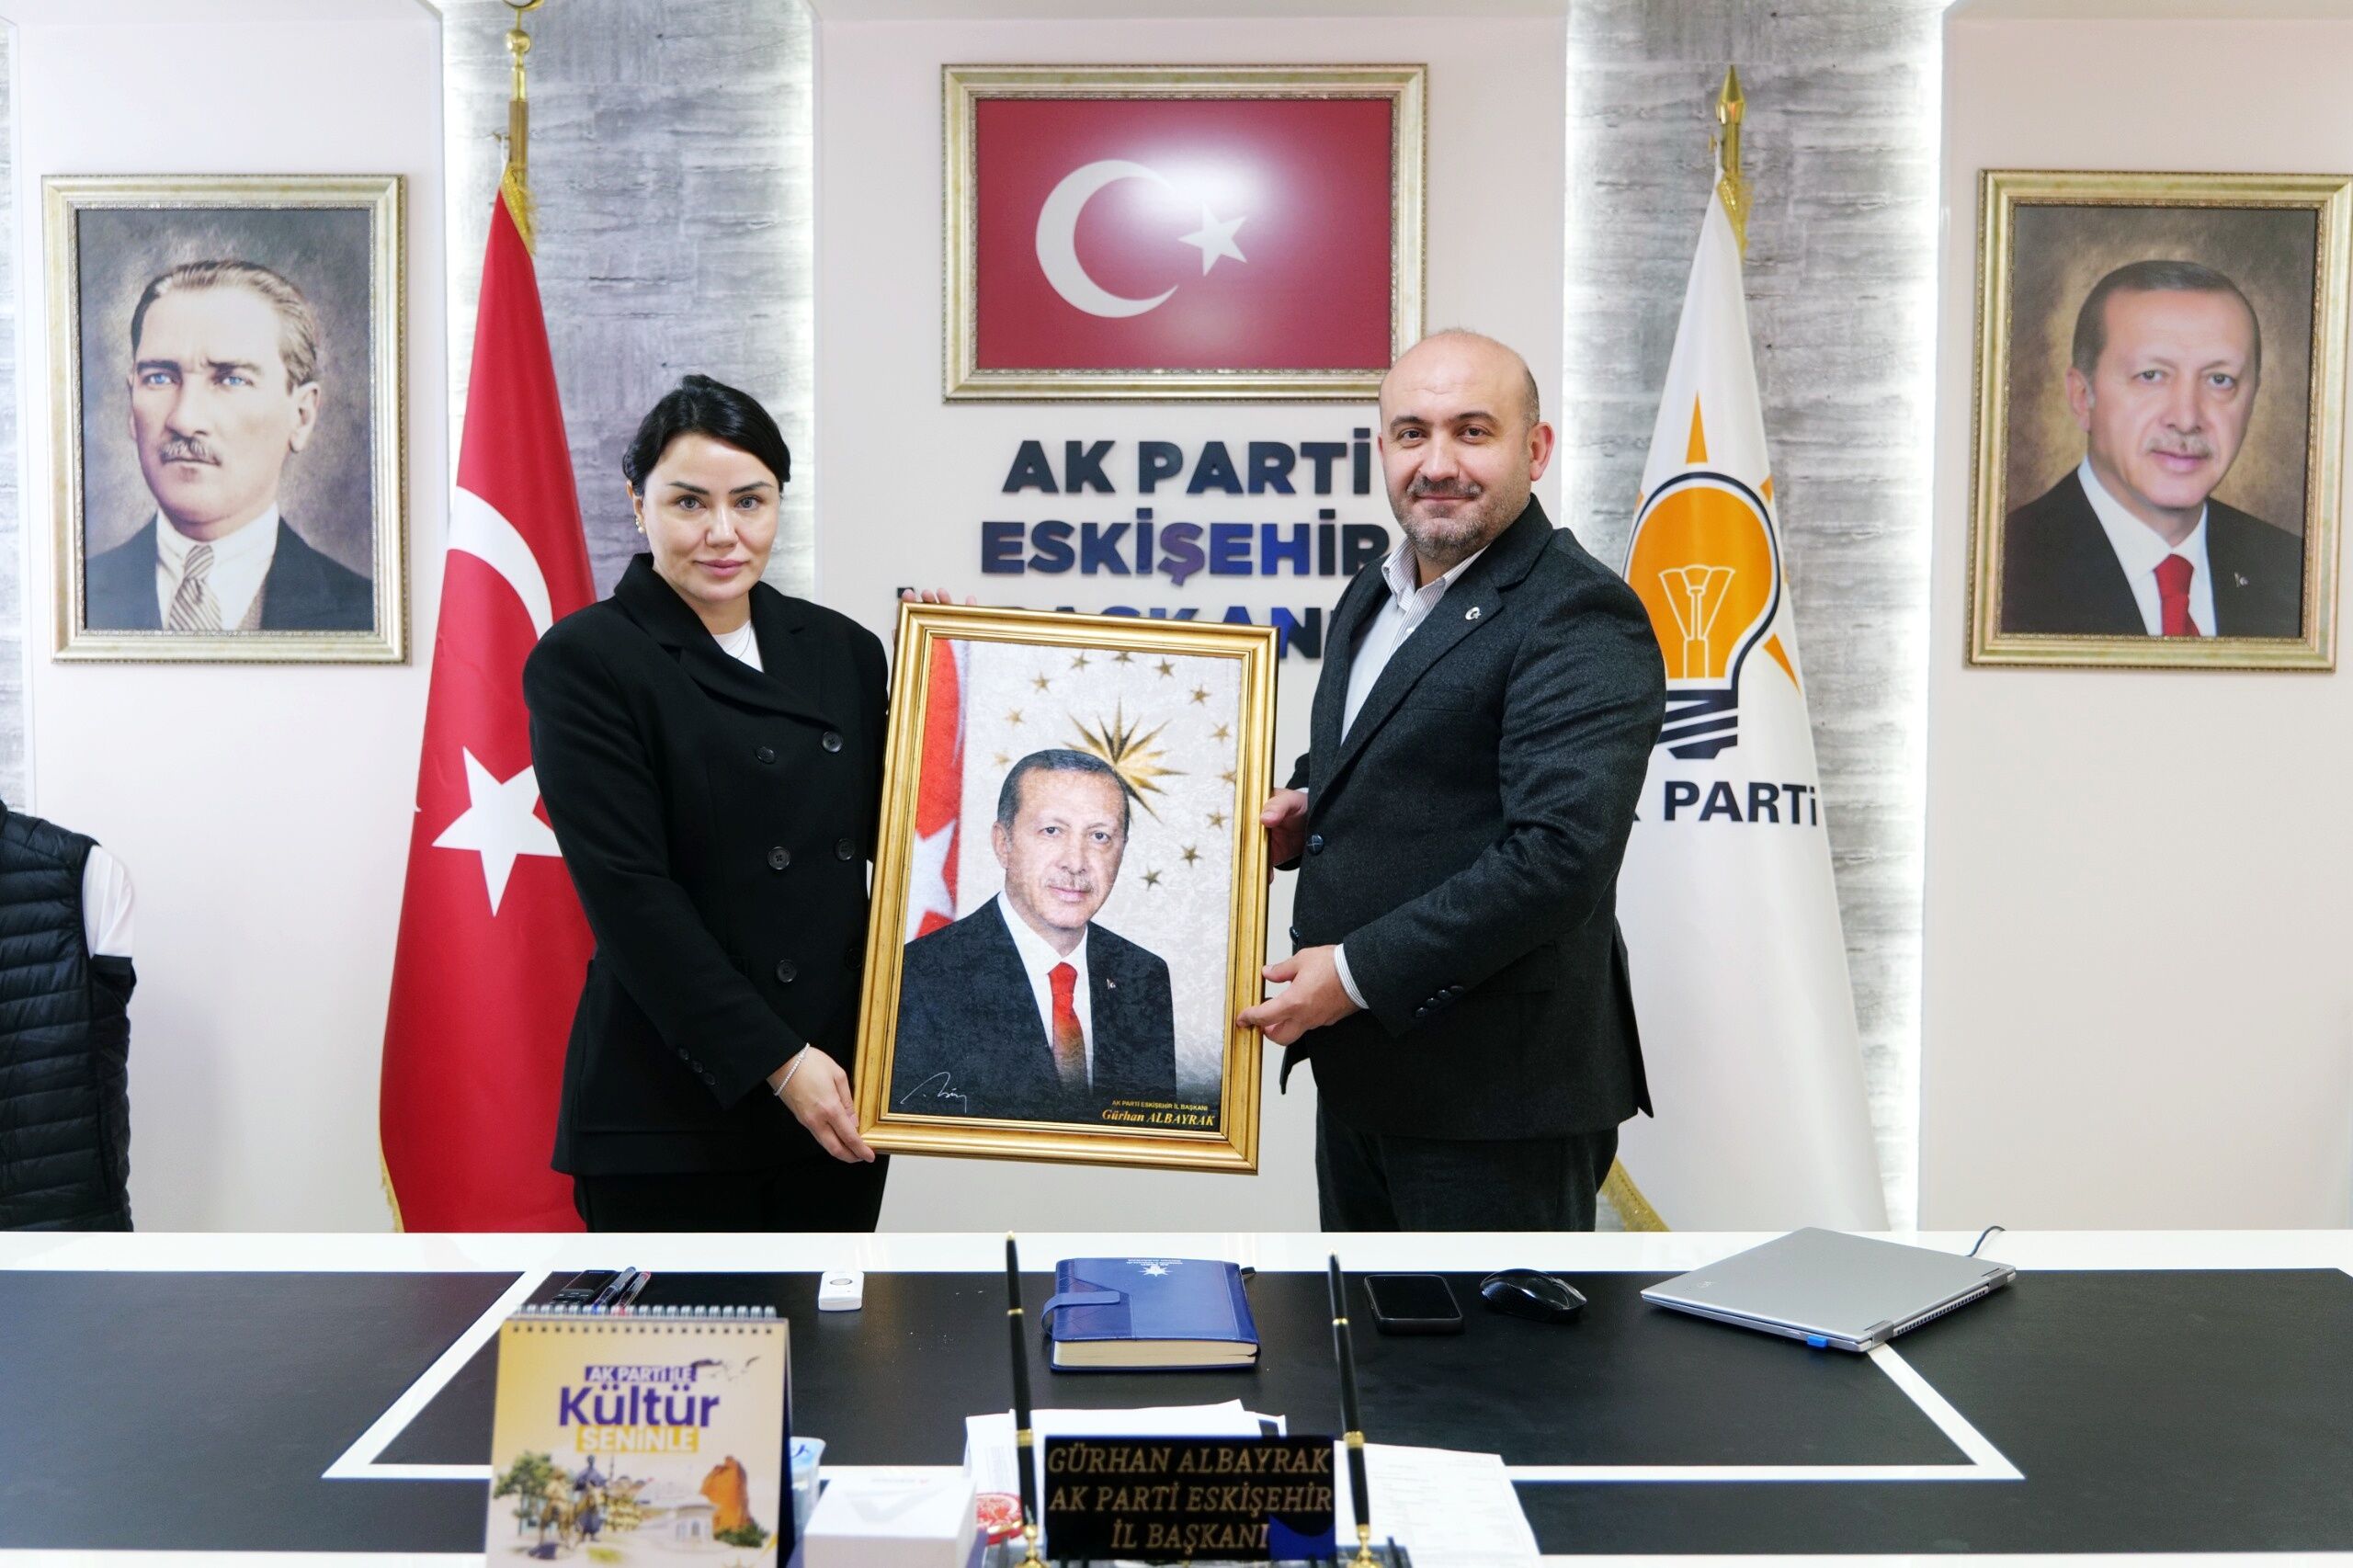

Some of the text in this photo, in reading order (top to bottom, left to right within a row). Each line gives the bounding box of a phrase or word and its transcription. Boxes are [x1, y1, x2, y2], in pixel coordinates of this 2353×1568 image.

[1002, 426, 1371, 495] AK PARTİ
[981, 507, 1390, 586] ESKİŞEHİR
[1102, 1108, 1216, 1127] Gürhan ALBAYRAK
[589, 1366, 614, 1381] AK
[559, 1383, 721, 1427] Kültür
[1047, 1442, 1172, 1473] GÜRHAN
[1176, 1447, 1332, 1473] ALBAYRAK
[1048, 1481, 1333, 1518] AK PARTİ ESKİŞEHİR
[1109, 1518, 1270, 1555] İL BAŞKANI
